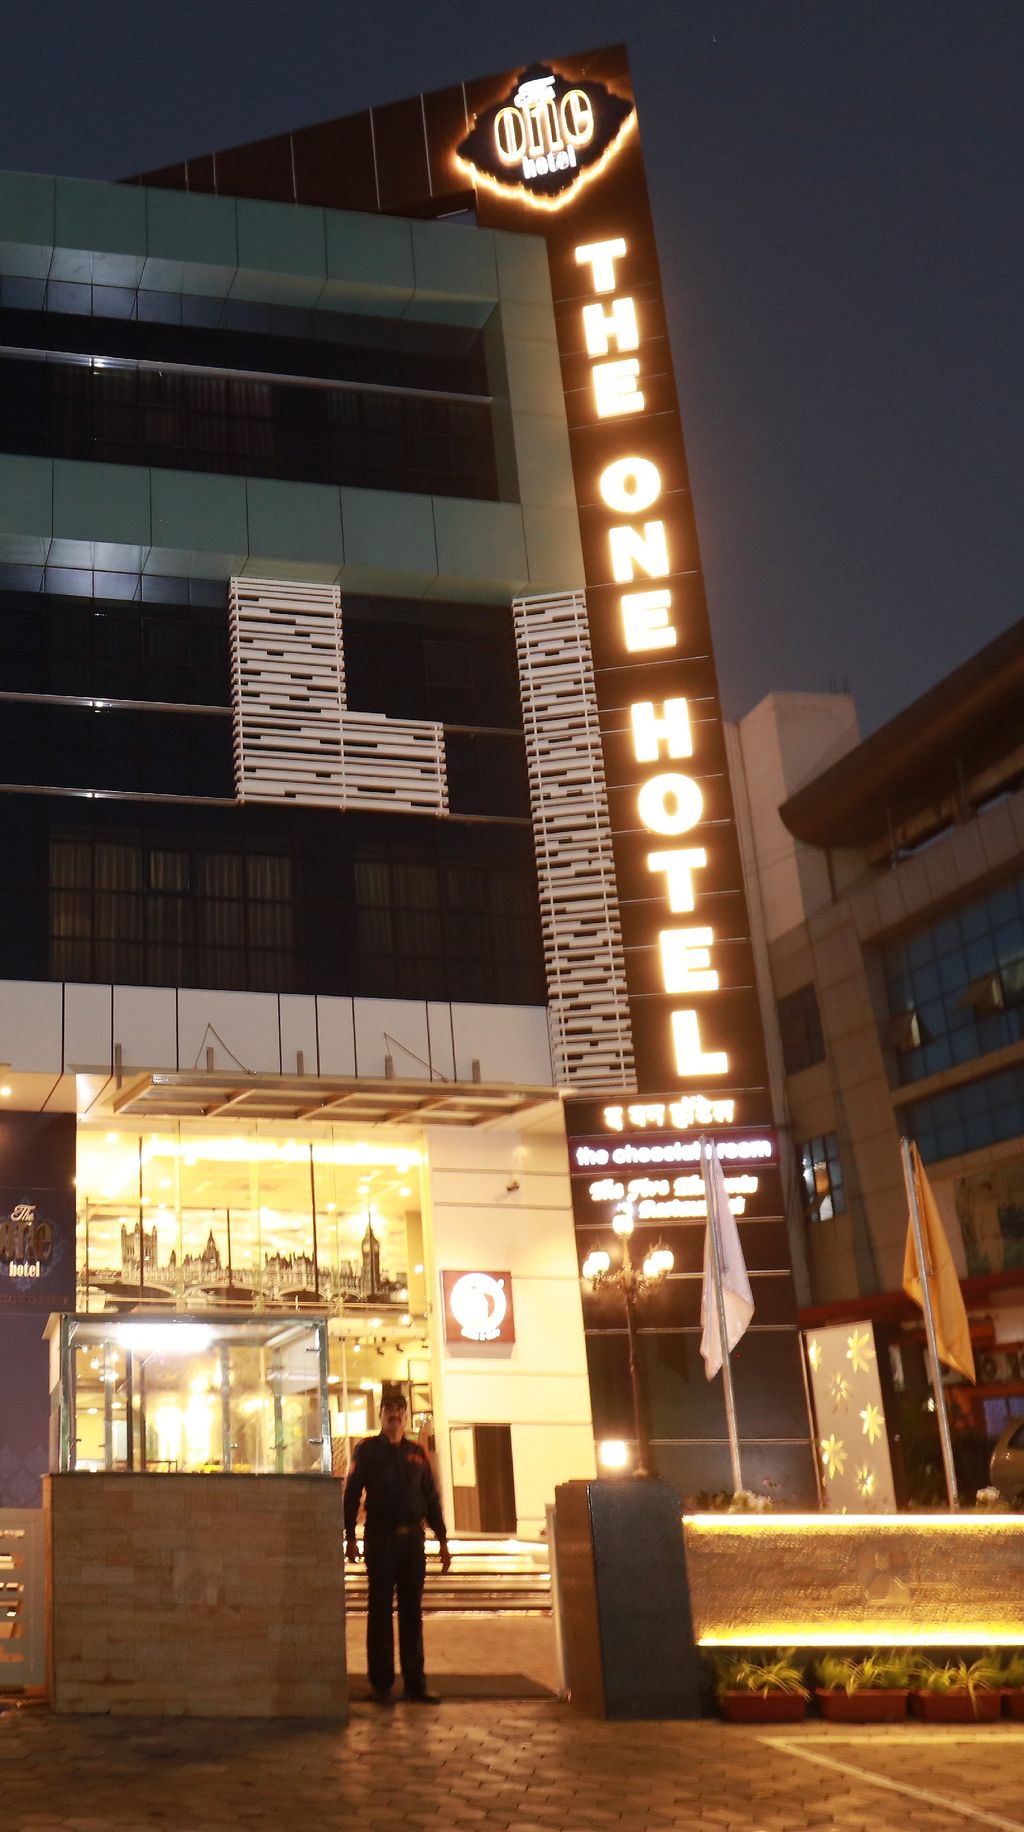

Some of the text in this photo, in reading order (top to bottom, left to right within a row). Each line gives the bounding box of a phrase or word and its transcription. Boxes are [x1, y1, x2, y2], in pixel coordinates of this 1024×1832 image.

[522, 144, 577, 179] hotel
[575, 238, 729, 1077] THE ONE HOTEL
[576, 1146, 610, 1166] the
[716, 1139, 772, 1160] room
[11, 1204, 36, 1222] The
[9, 1260, 41, 1278] hotel
